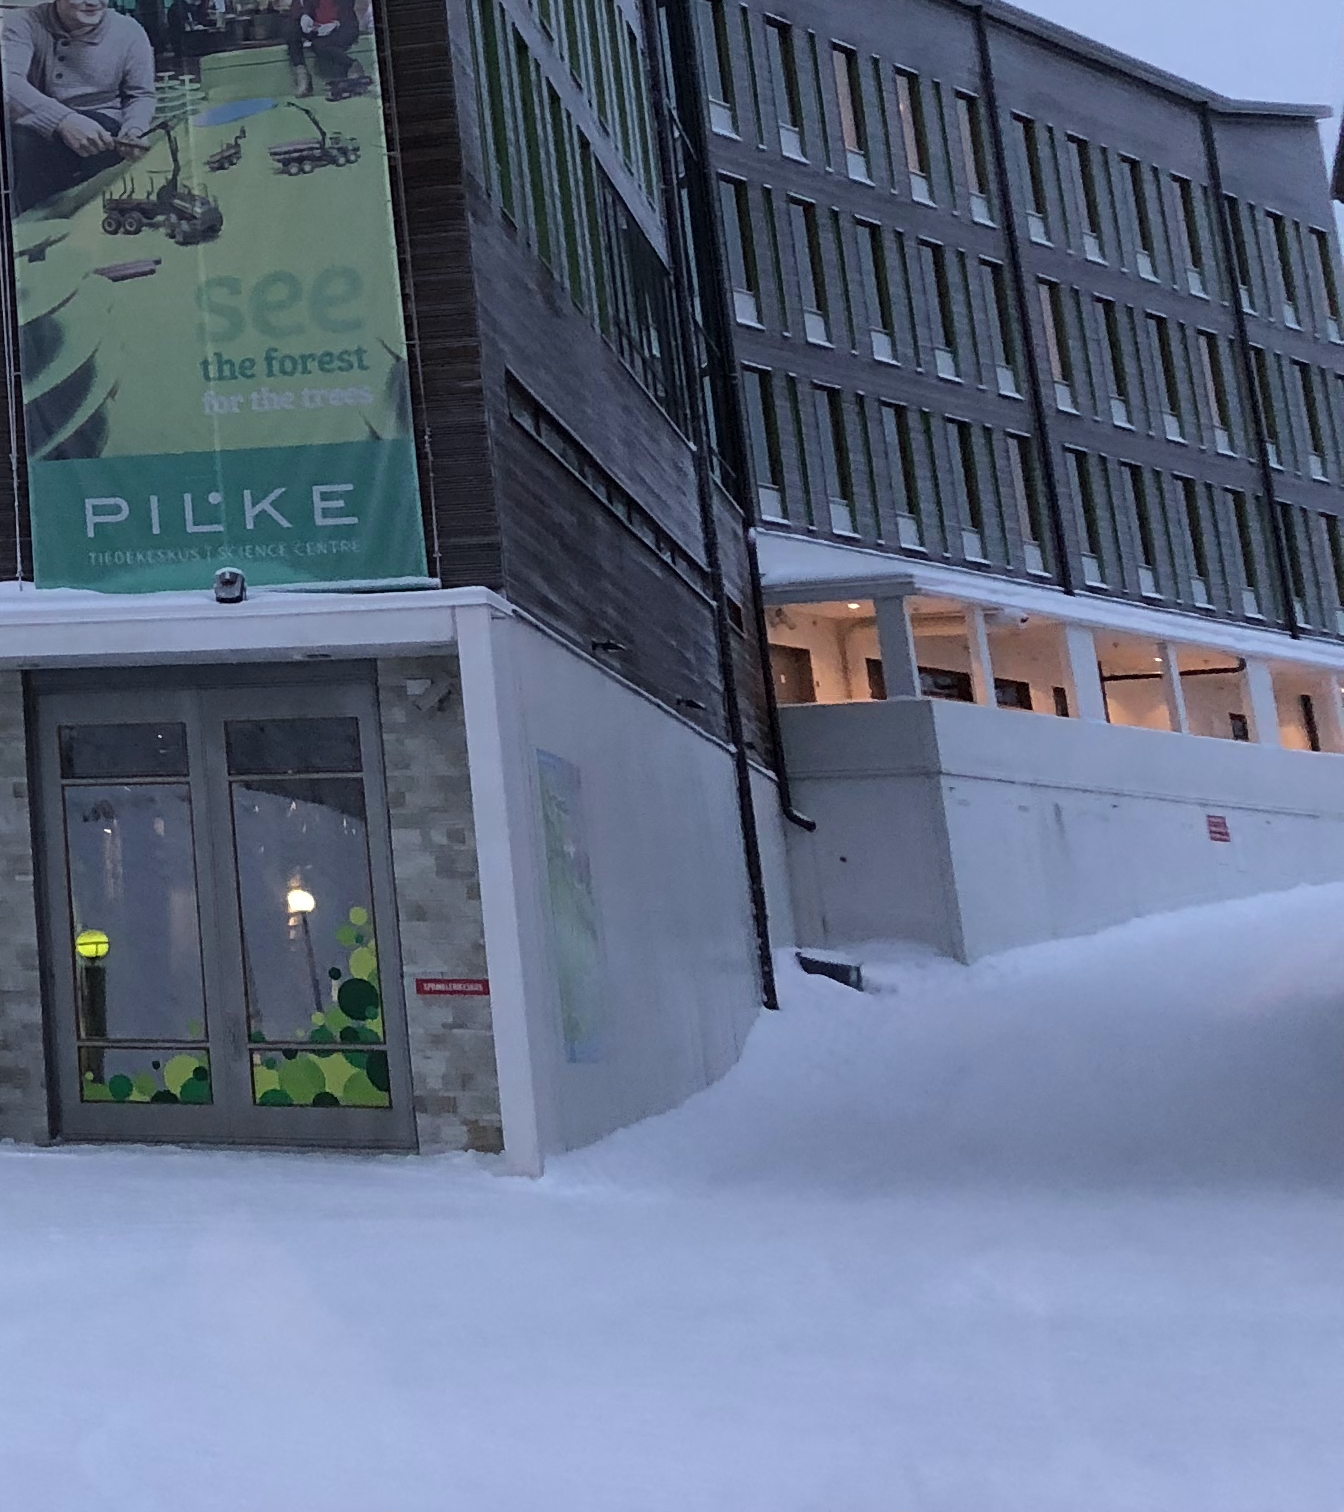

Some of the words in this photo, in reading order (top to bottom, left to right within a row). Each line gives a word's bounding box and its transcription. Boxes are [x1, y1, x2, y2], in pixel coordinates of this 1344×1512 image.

[195, 264, 367, 343] see
[199, 351, 257, 382] the
[264, 345, 370, 378] forest
[202, 390, 244, 415] for
[250, 386, 296, 411] the
[301, 385, 374, 409] trees
[84, 484, 359, 538] PILKE
[88, 547, 200, 566] TIEDEKESKUS
[218, 542, 288, 560] SCIENCE
[293, 540, 362, 557] CENTRE
